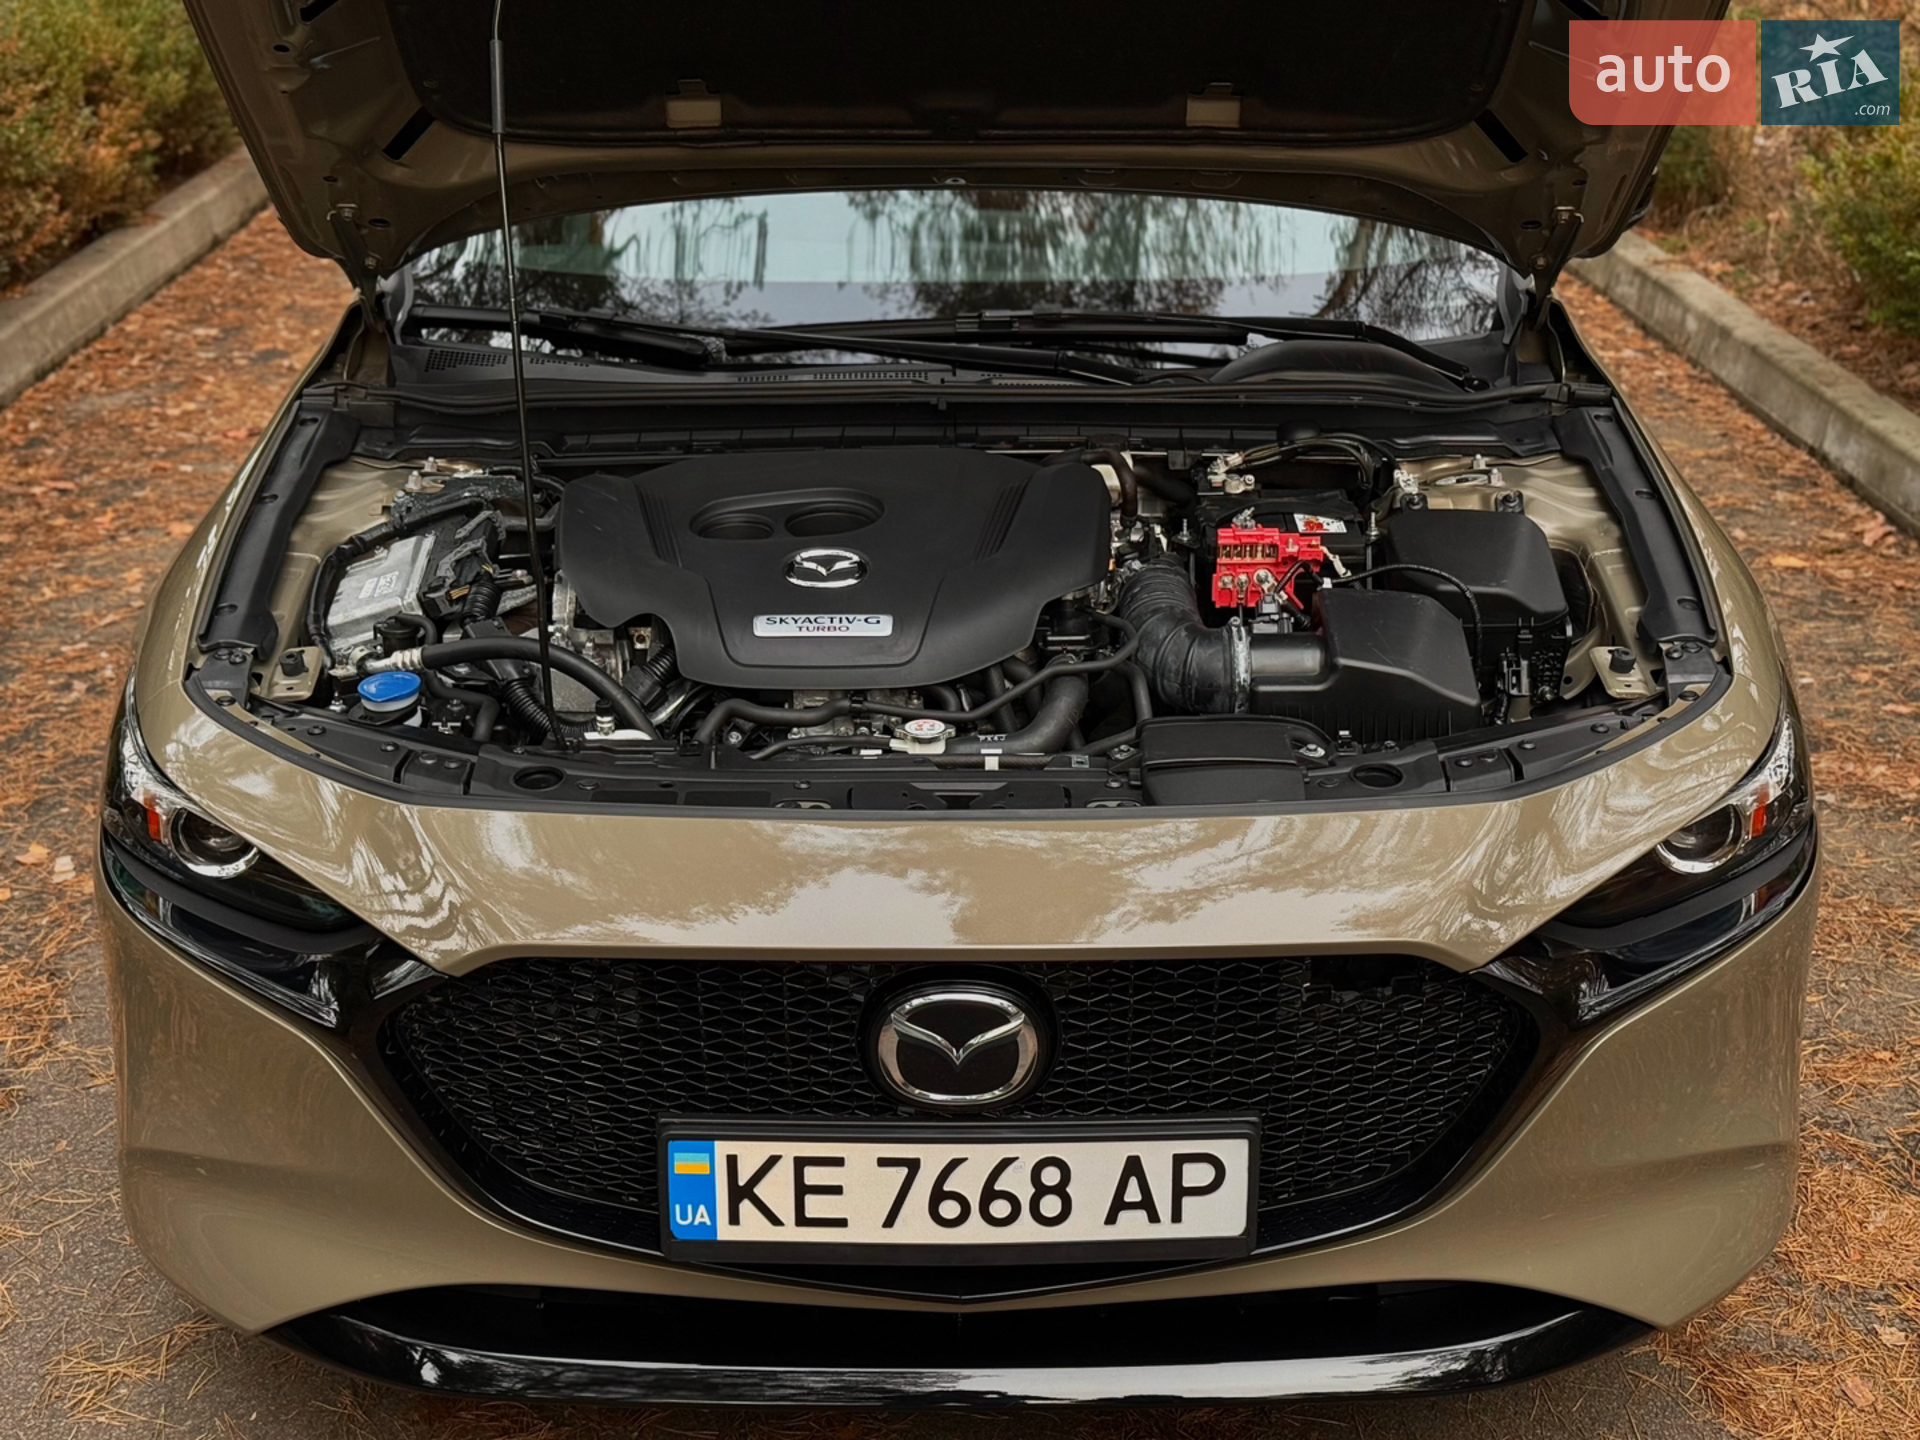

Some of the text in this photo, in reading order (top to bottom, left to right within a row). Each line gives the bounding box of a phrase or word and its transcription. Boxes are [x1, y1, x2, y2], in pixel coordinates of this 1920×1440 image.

[765, 616, 881, 625] SKYACTIV-G
[796, 625, 850, 633] TURBO
[726, 1152, 1227, 1229] KE 7668 AP
[675, 1204, 712, 1227] UA
